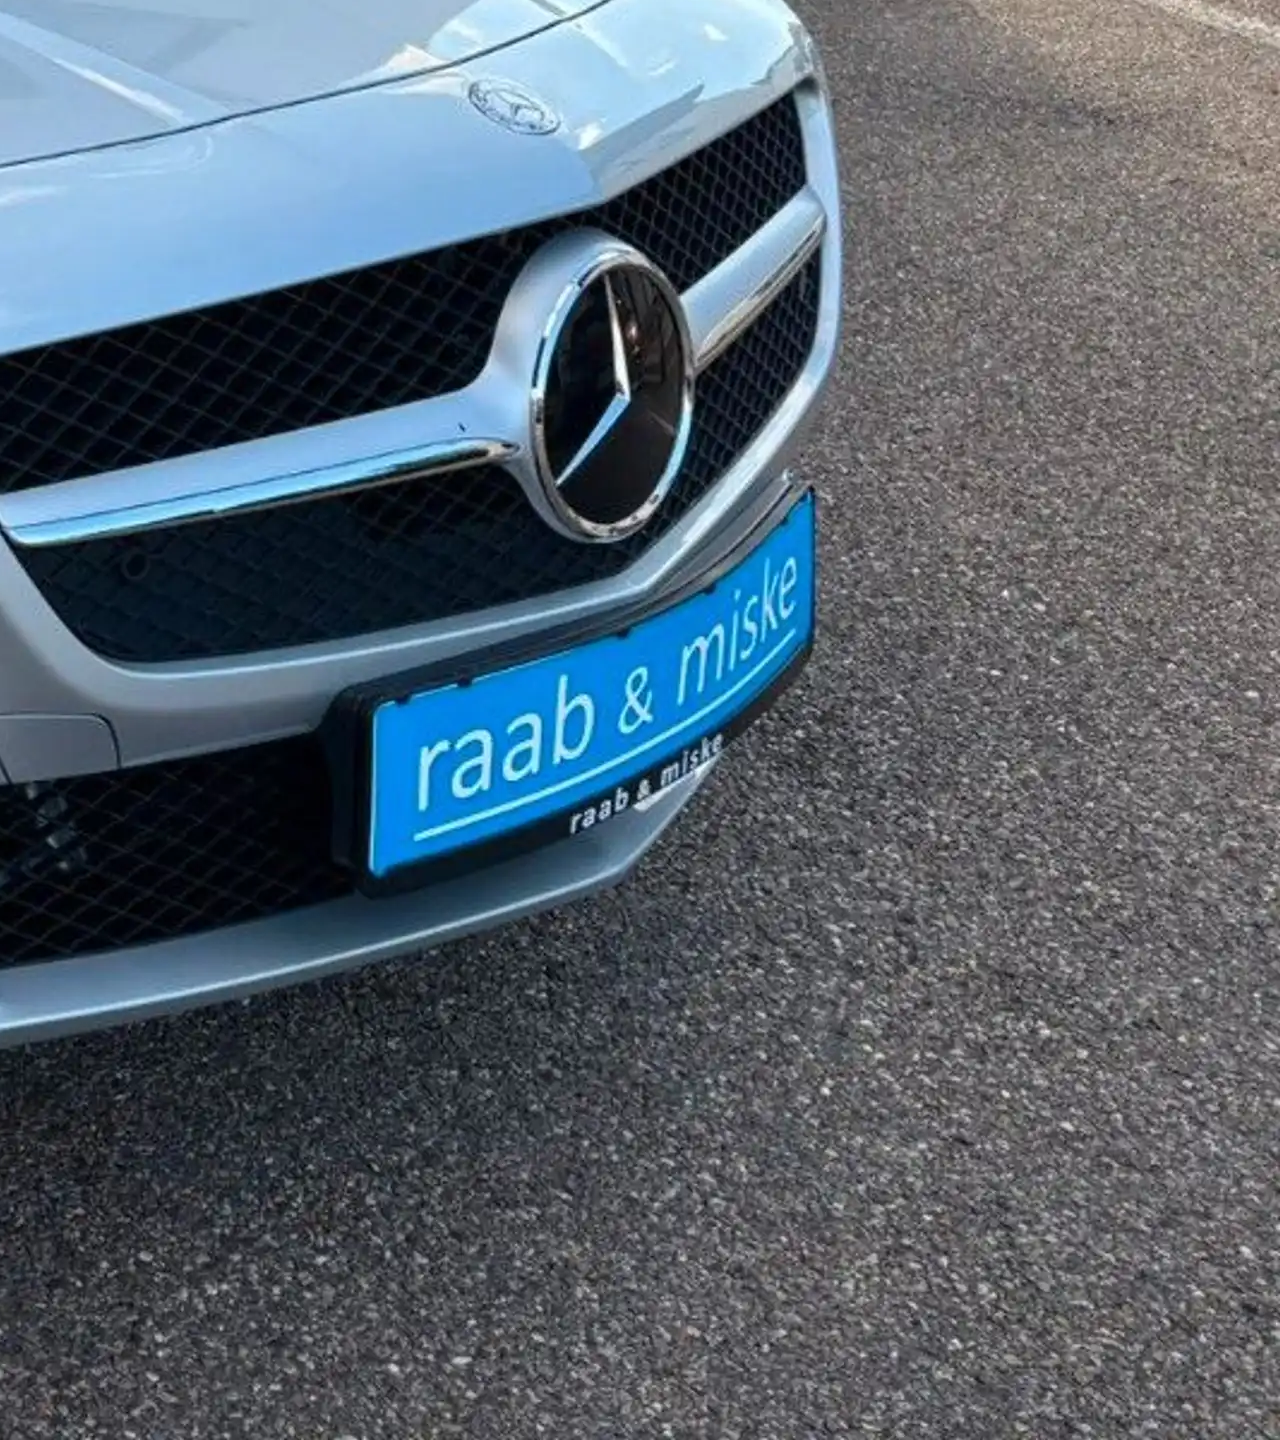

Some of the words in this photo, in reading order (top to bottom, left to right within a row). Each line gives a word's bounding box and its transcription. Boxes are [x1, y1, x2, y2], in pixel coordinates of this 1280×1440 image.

[417, 673, 595, 812] raab
[617, 665, 654, 734] &
[675, 556, 799, 706] miske
[569, 786, 630, 835] raab
[635, 776, 651, 798] &
[659, 733, 724, 788] miske
